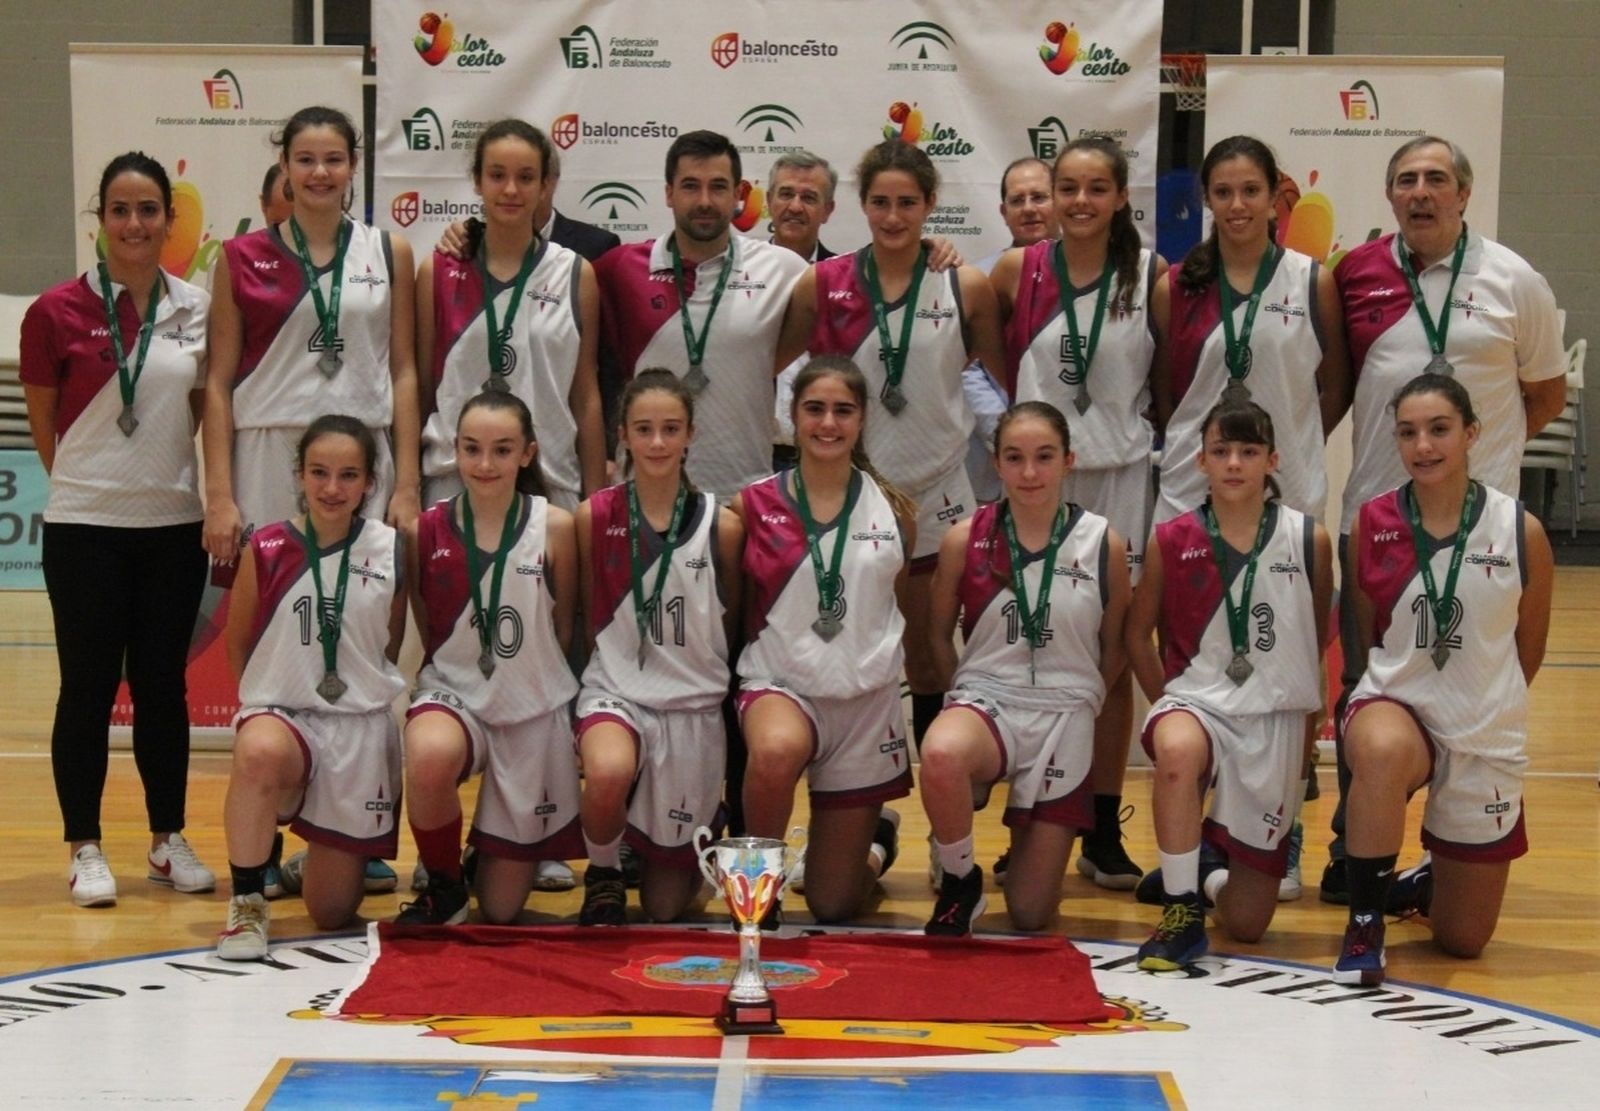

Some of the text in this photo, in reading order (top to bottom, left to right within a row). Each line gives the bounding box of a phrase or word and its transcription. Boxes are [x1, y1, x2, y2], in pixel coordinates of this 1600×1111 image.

[609, 37, 659, 47] Federación
[609, 48, 654, 57] Andaluza
[609, 59, 672, 68] de Baloncesto
[1289, 127, 1332, 136] Federación
[1333, 128, 1371, 136] Andaluza
[1373, 128, 1382, 136] de
[422, 200, 487, 215] balonce
[927, 214, 965, 224] ndaluza
[348, 568, 387, 582] ORDOBA
[516, 566, 543, 577] CORD
[1044, 767, 1065, 779] DB
[1484, 801, 1510, 814] CDB
[1262, 812, 1281, 828] CD
